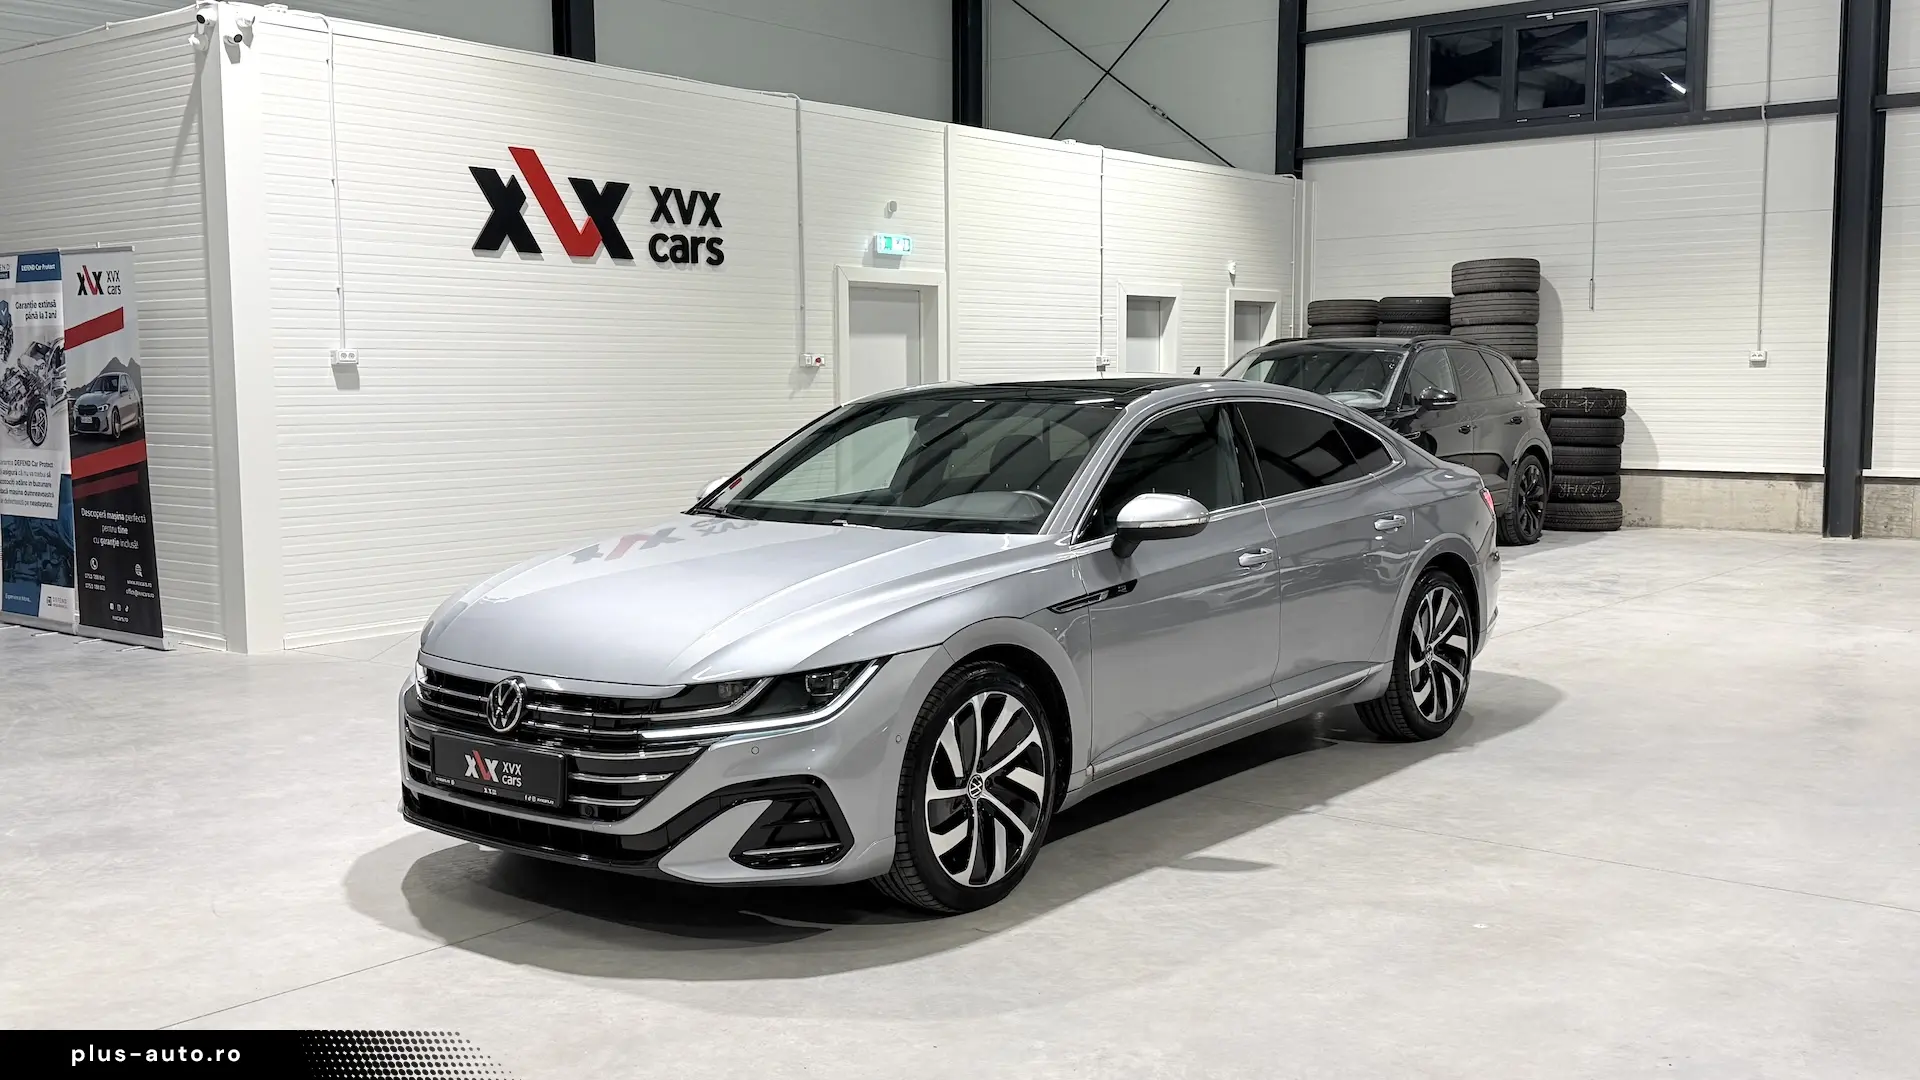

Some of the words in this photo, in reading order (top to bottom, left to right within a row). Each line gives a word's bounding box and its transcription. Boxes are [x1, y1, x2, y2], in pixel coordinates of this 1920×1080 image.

[649, 186, 721, 228] XVX
[649, 233, 725, 266] cars
[106, 270, 121, 282] XVX
[106, 285, 122, 295] cars
[38, 300, 57, 308] extinsă
[39, 311, 44, 320] la
[48, 310, 57, 318] ani
[106, 511, 125, 522] mașina
[125, 513, 146, 523] perfectă
[118, 525, 128, 534] tine
[502, 762, 522, 776] XVX
[502, 775, 522, 787] cars
